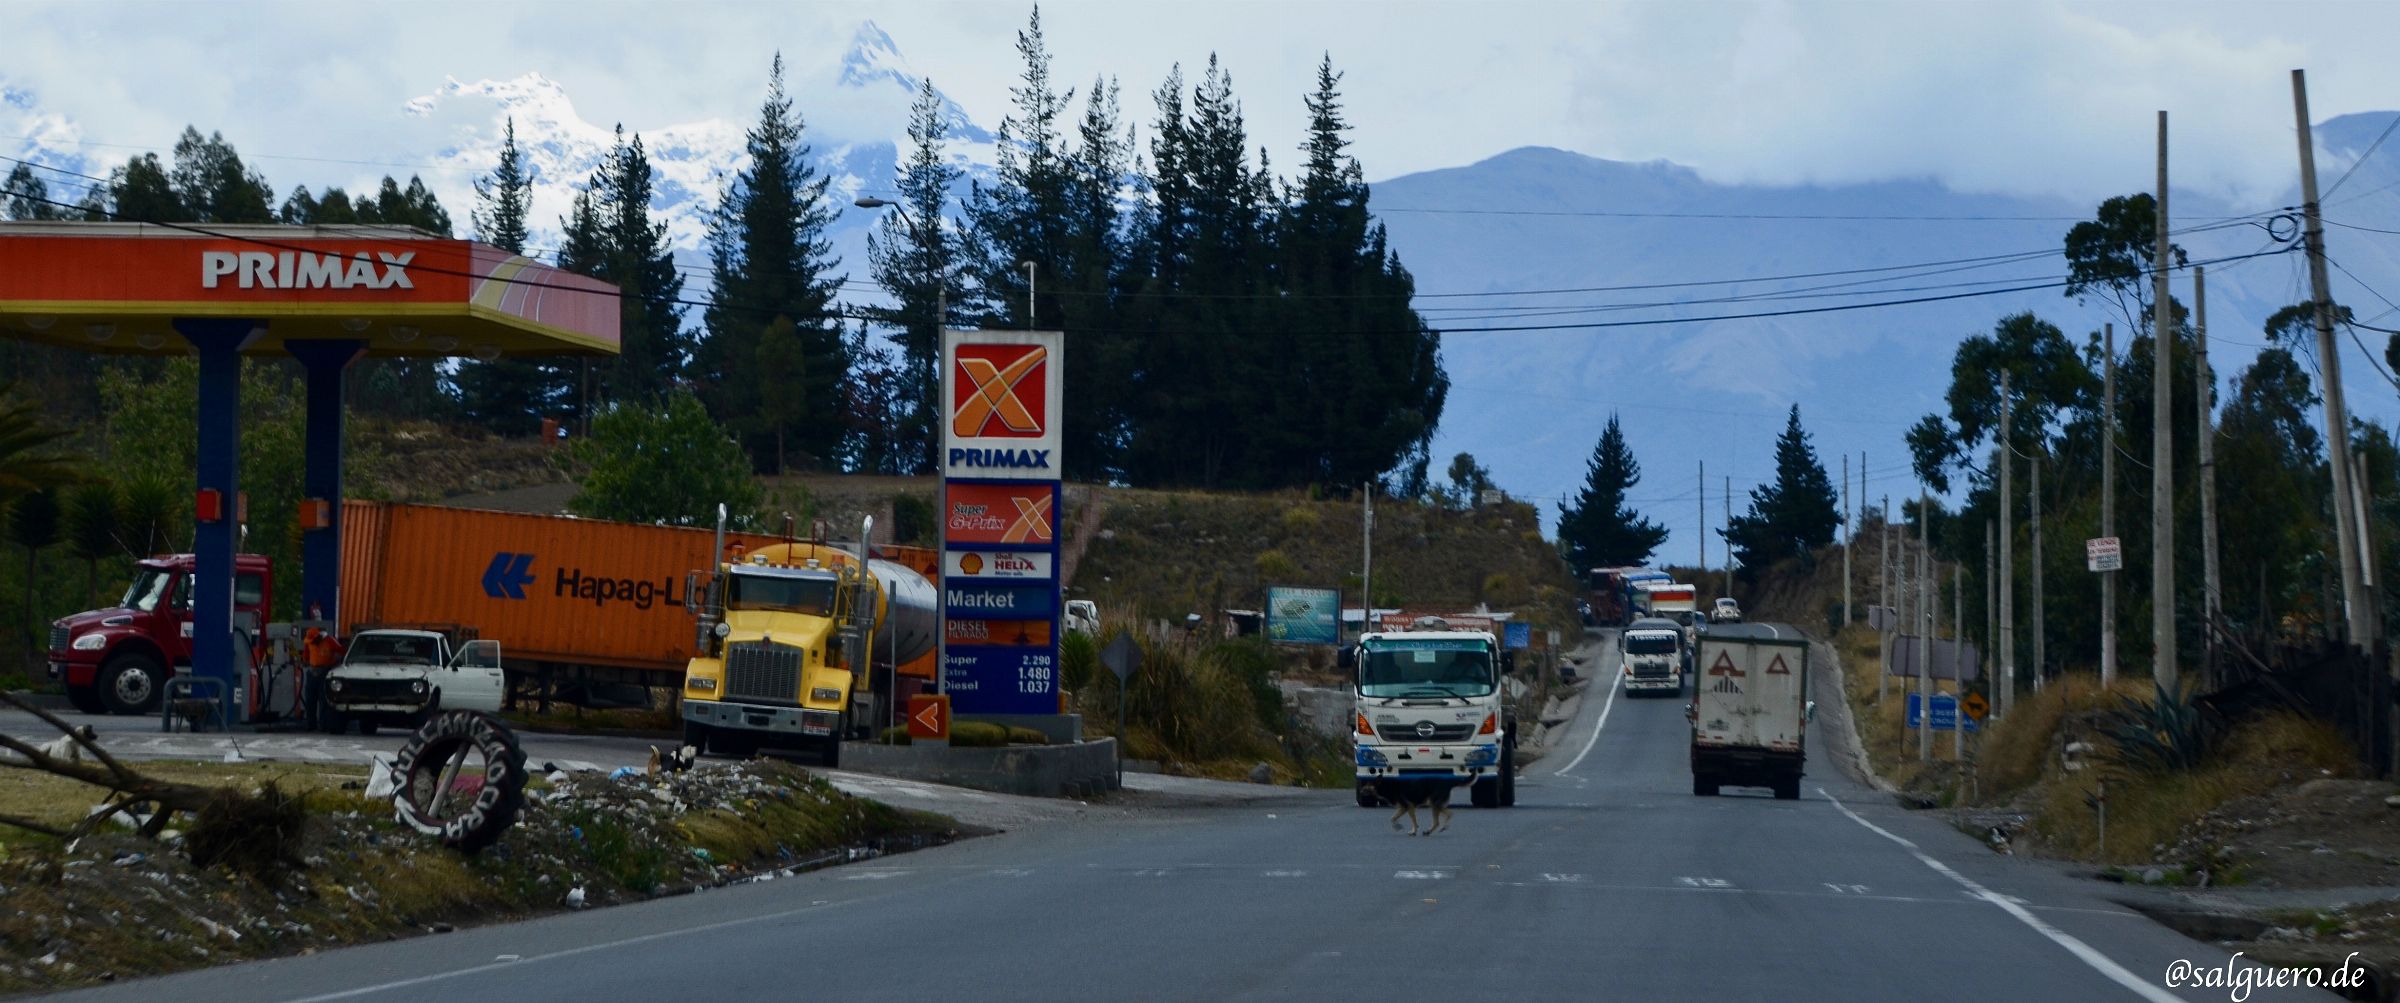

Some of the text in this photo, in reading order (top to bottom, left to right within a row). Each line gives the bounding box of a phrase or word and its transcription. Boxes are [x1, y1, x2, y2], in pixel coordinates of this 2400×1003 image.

[202, 250, 416, 290] PRIMAX
[949, 448, 1050, 469] PRIMAX
[952, 502, 988, 516] Super
[949, 515, 1006, 531] G-Prix
[994, 558, 1036, 571] HELIX
[947, 590, 1015, 608] Market
[948, 620, 989, 632] DIESEL
[948, 631, 990, 640] FILTRADO
[944, 654, 1051, 666] Super 2.290
[1018, 666, 1051, 680] 1.480
[1018, 680, 1050, 693] 1.037
